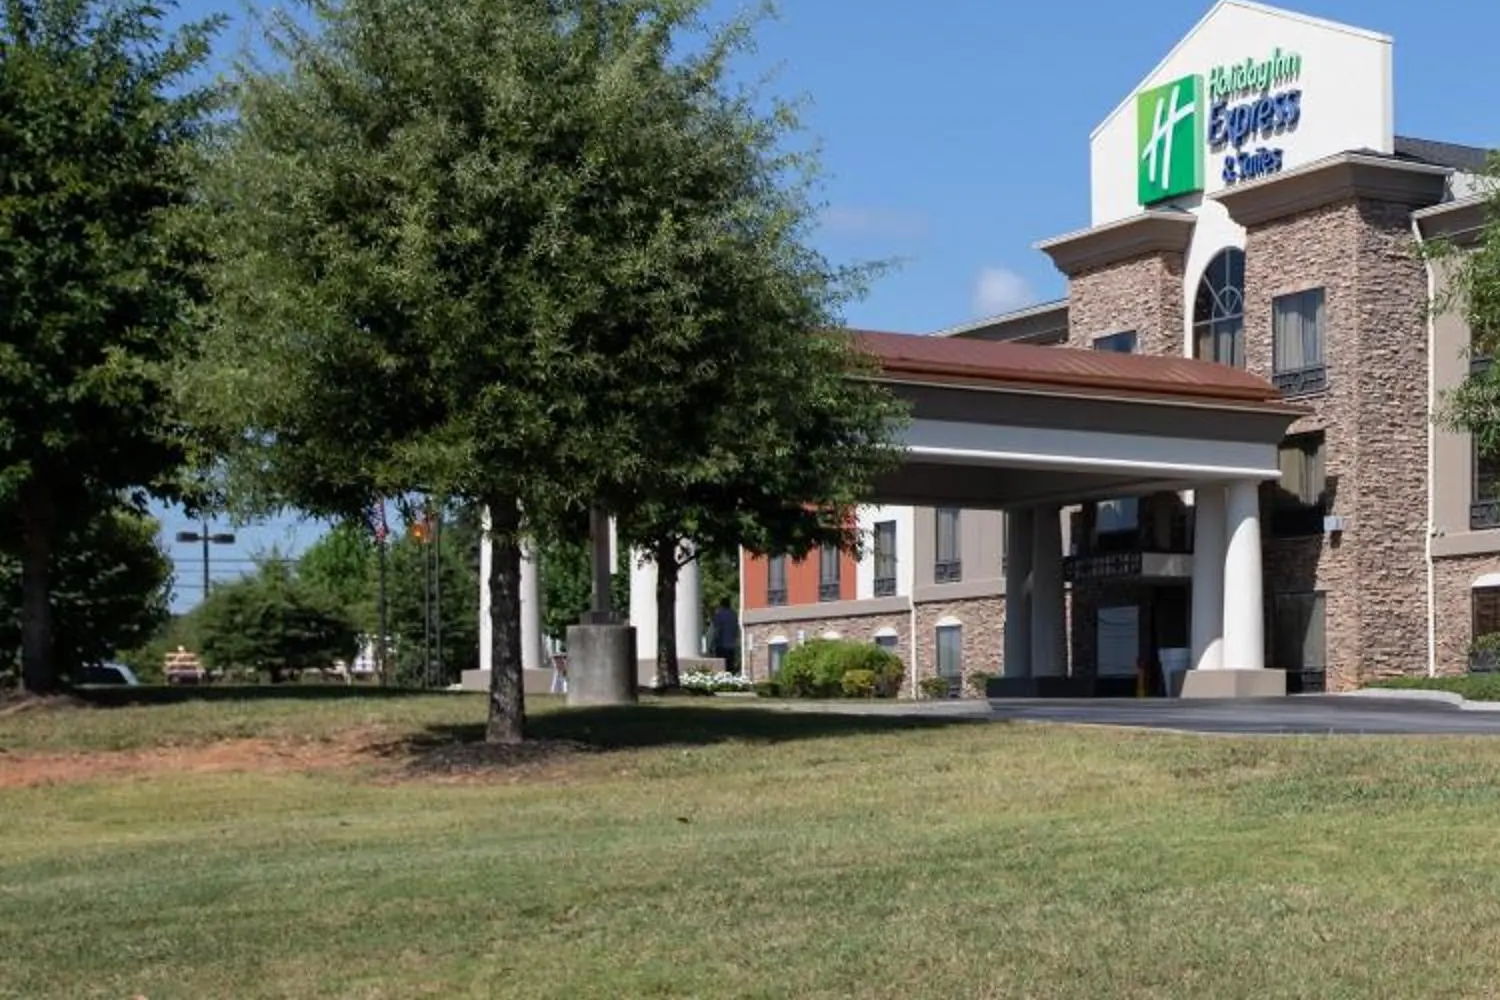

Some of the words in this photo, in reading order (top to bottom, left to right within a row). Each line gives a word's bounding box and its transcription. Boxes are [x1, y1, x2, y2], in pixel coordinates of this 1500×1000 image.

[1209, 57, 1273, 98] Holiday
[1271, 47, 1301, 84] Inn
[1208, 90, 1301, 150] Express
[1222, 155, 1238, 183] &
[1238, 148, 1283, 179] Suites
